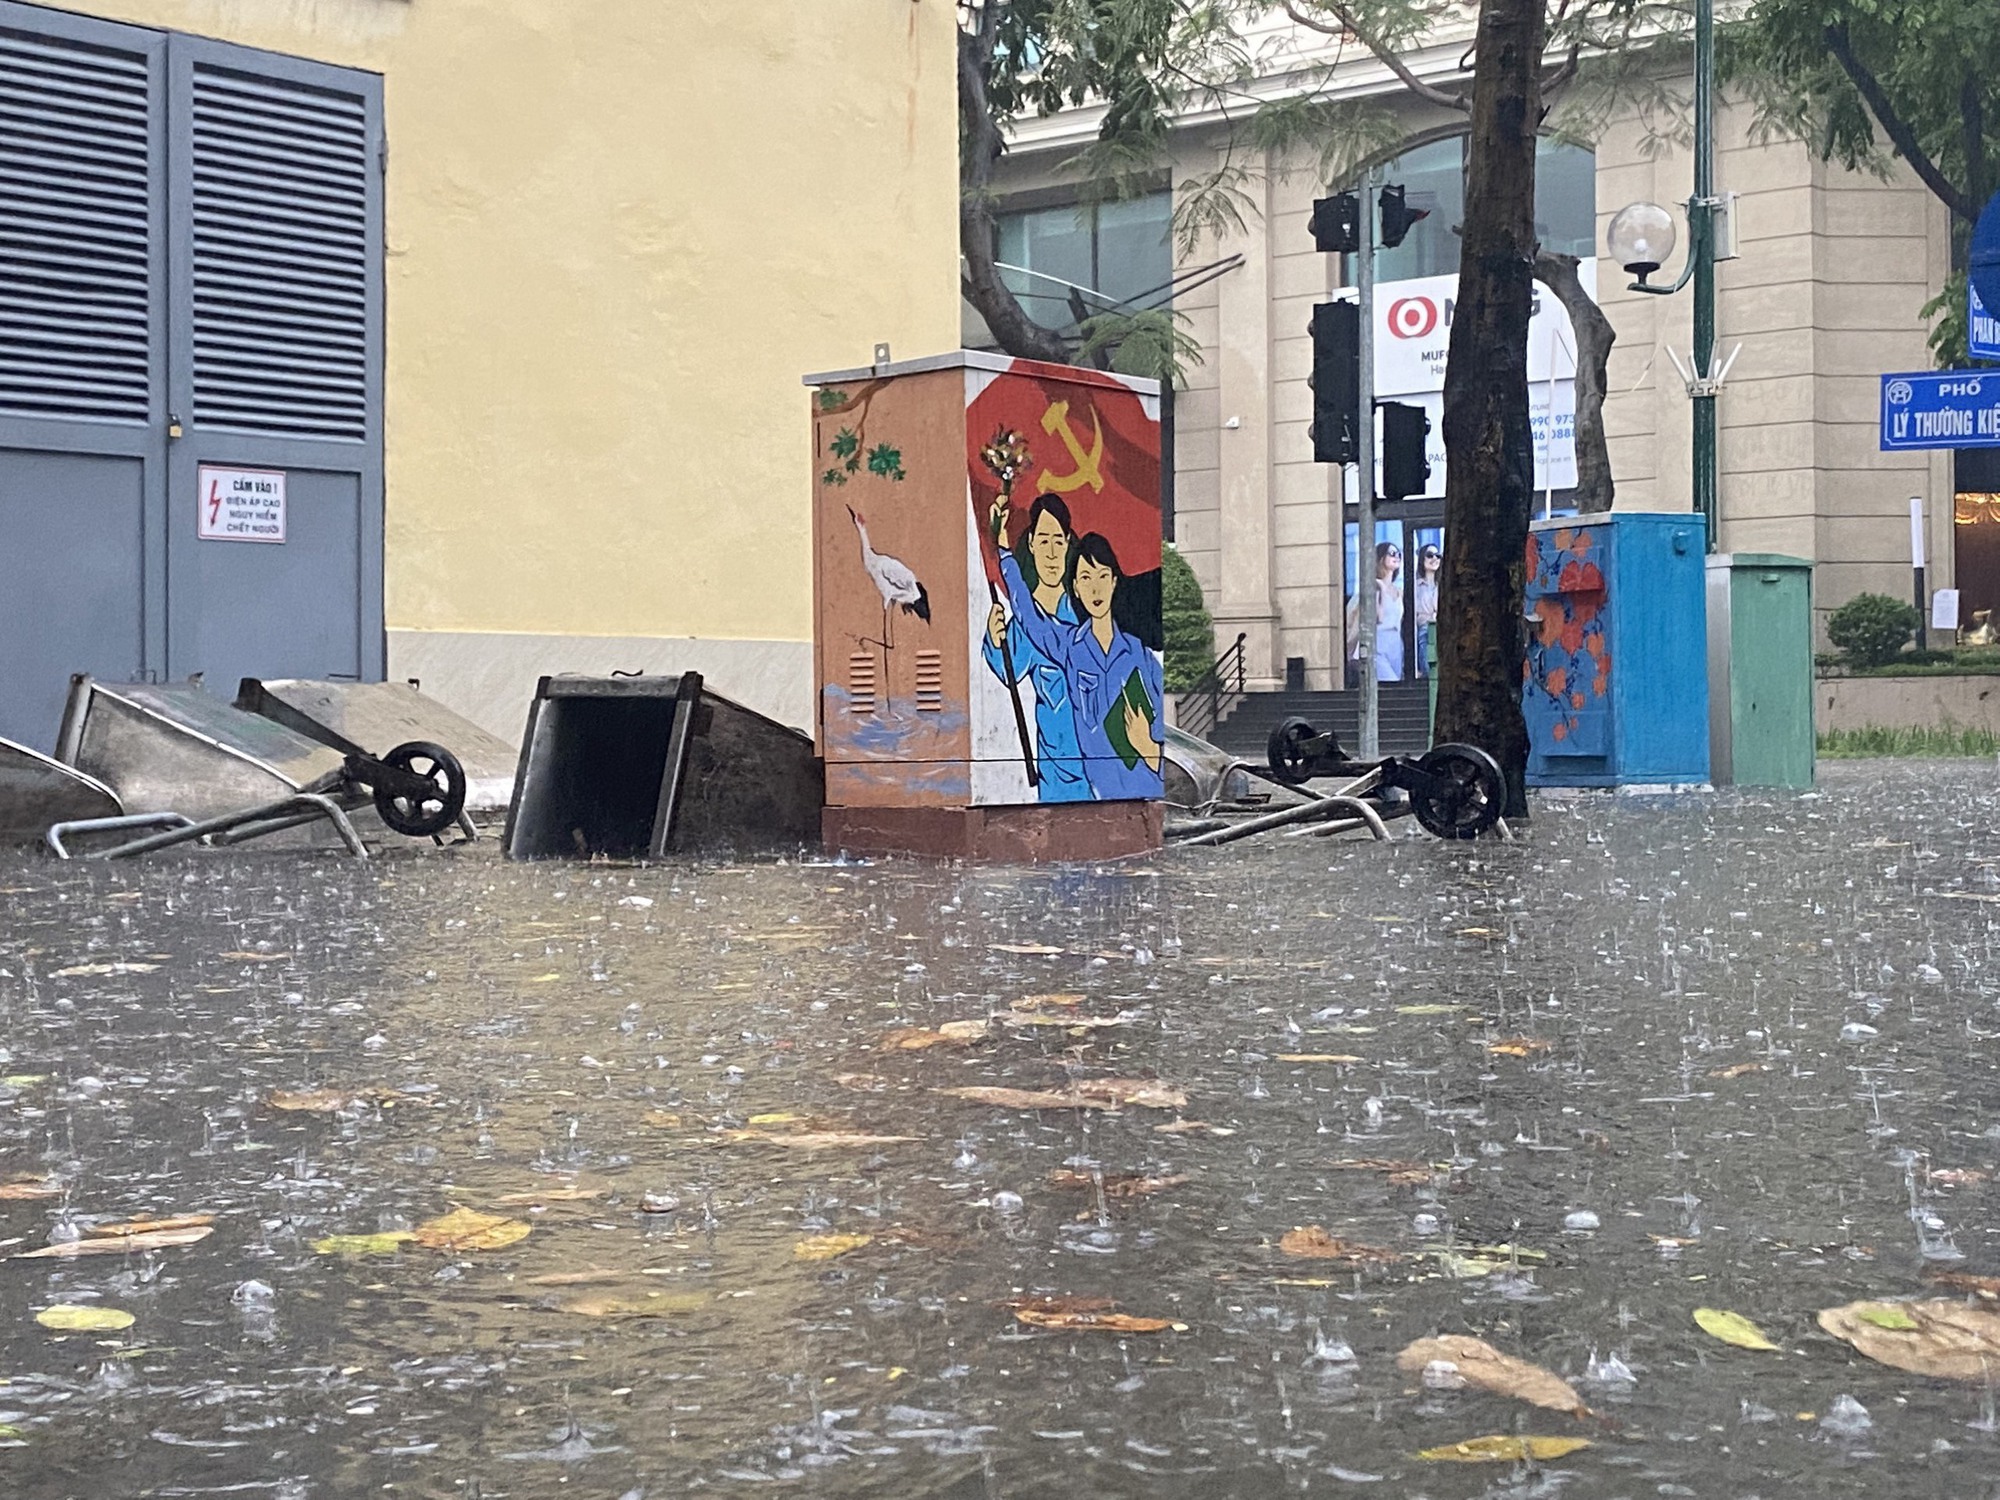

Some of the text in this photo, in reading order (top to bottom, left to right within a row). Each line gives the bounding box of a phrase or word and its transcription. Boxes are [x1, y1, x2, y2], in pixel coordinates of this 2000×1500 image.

[1938, 376, 1983, 397] PHỐ
[1893, 407, 1909, 438] LÝ
[1914, 405, 1973, 438] THƯỜNG
[263, 499, 281, 508] CAO
